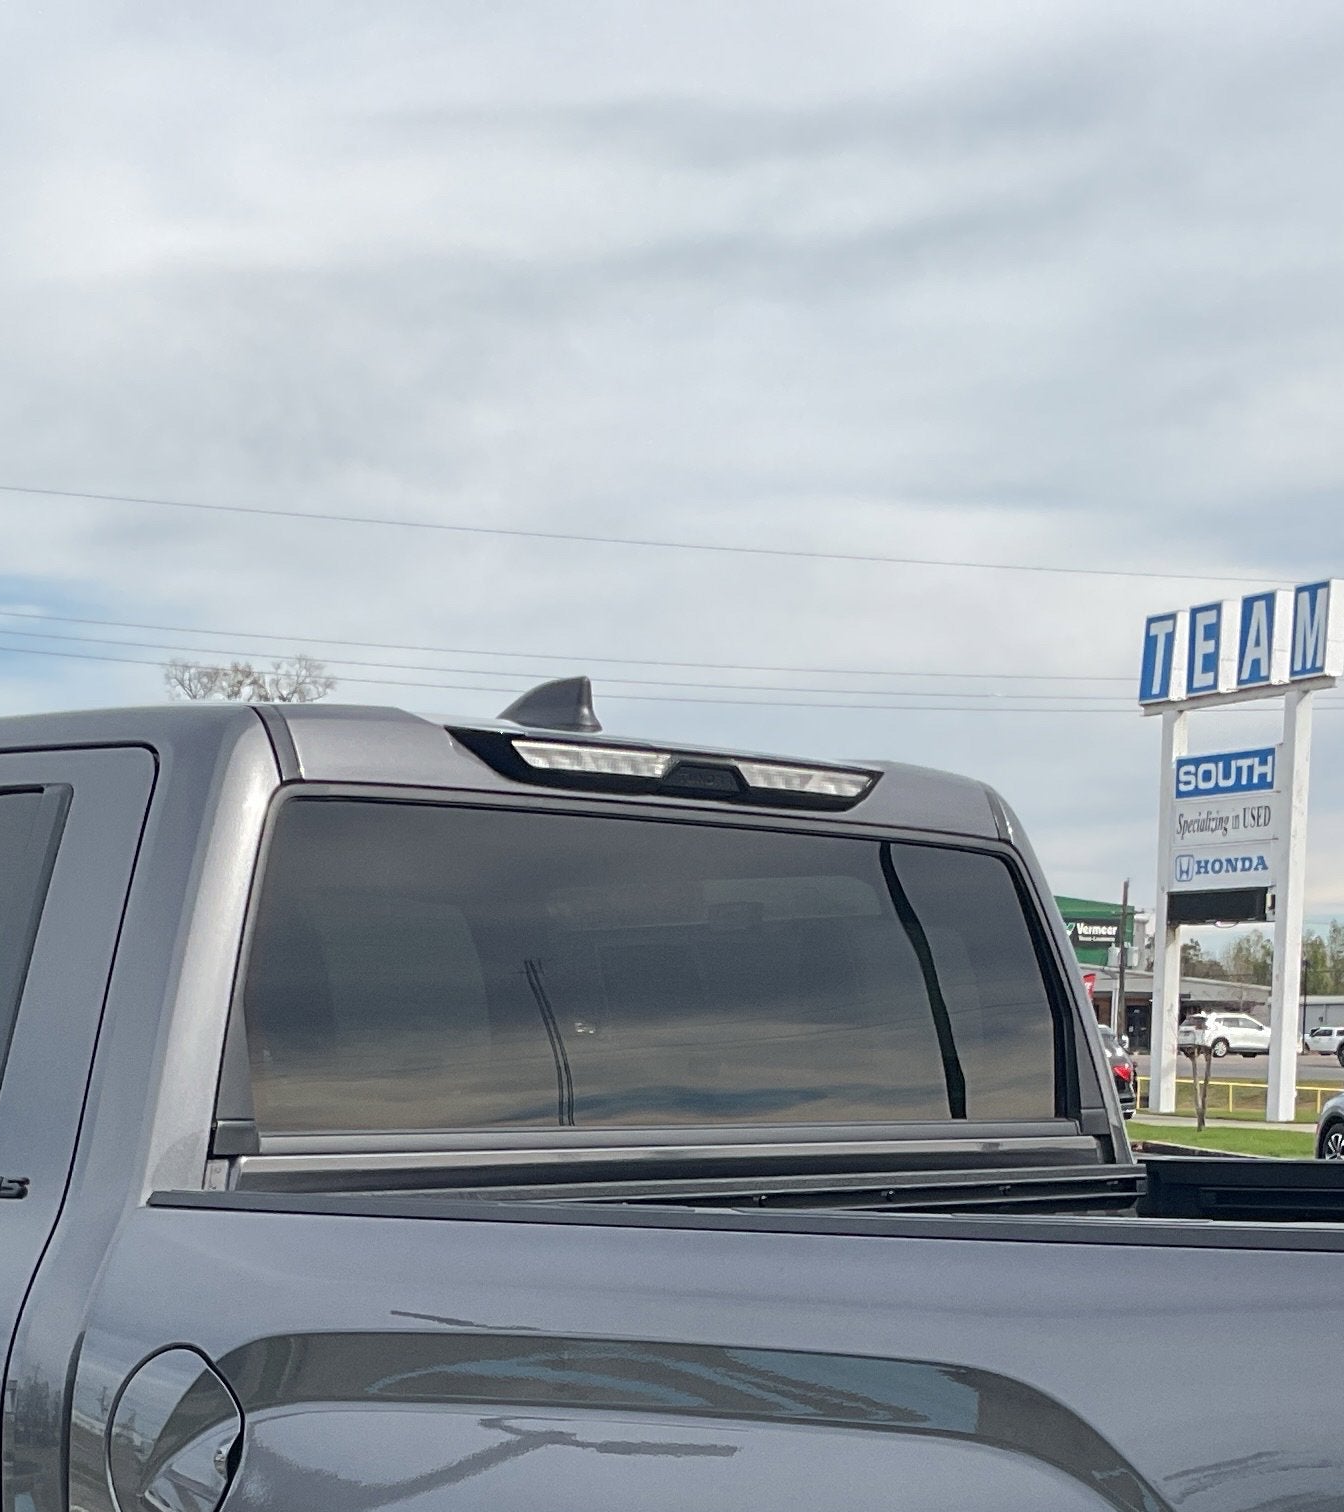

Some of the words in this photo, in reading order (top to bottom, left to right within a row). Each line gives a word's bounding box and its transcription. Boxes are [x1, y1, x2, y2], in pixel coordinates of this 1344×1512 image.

[1149, 590, 1328, 696] TEAM
[1178, 755, 1273, 792] SOUTH
[1176, 811, 1229, 840] Specializing
[1242, 805, 1271, 829] USED
[1195, 855, 1269, 875] HONDA
[1076, 922, 1118, 935] Vermeer
